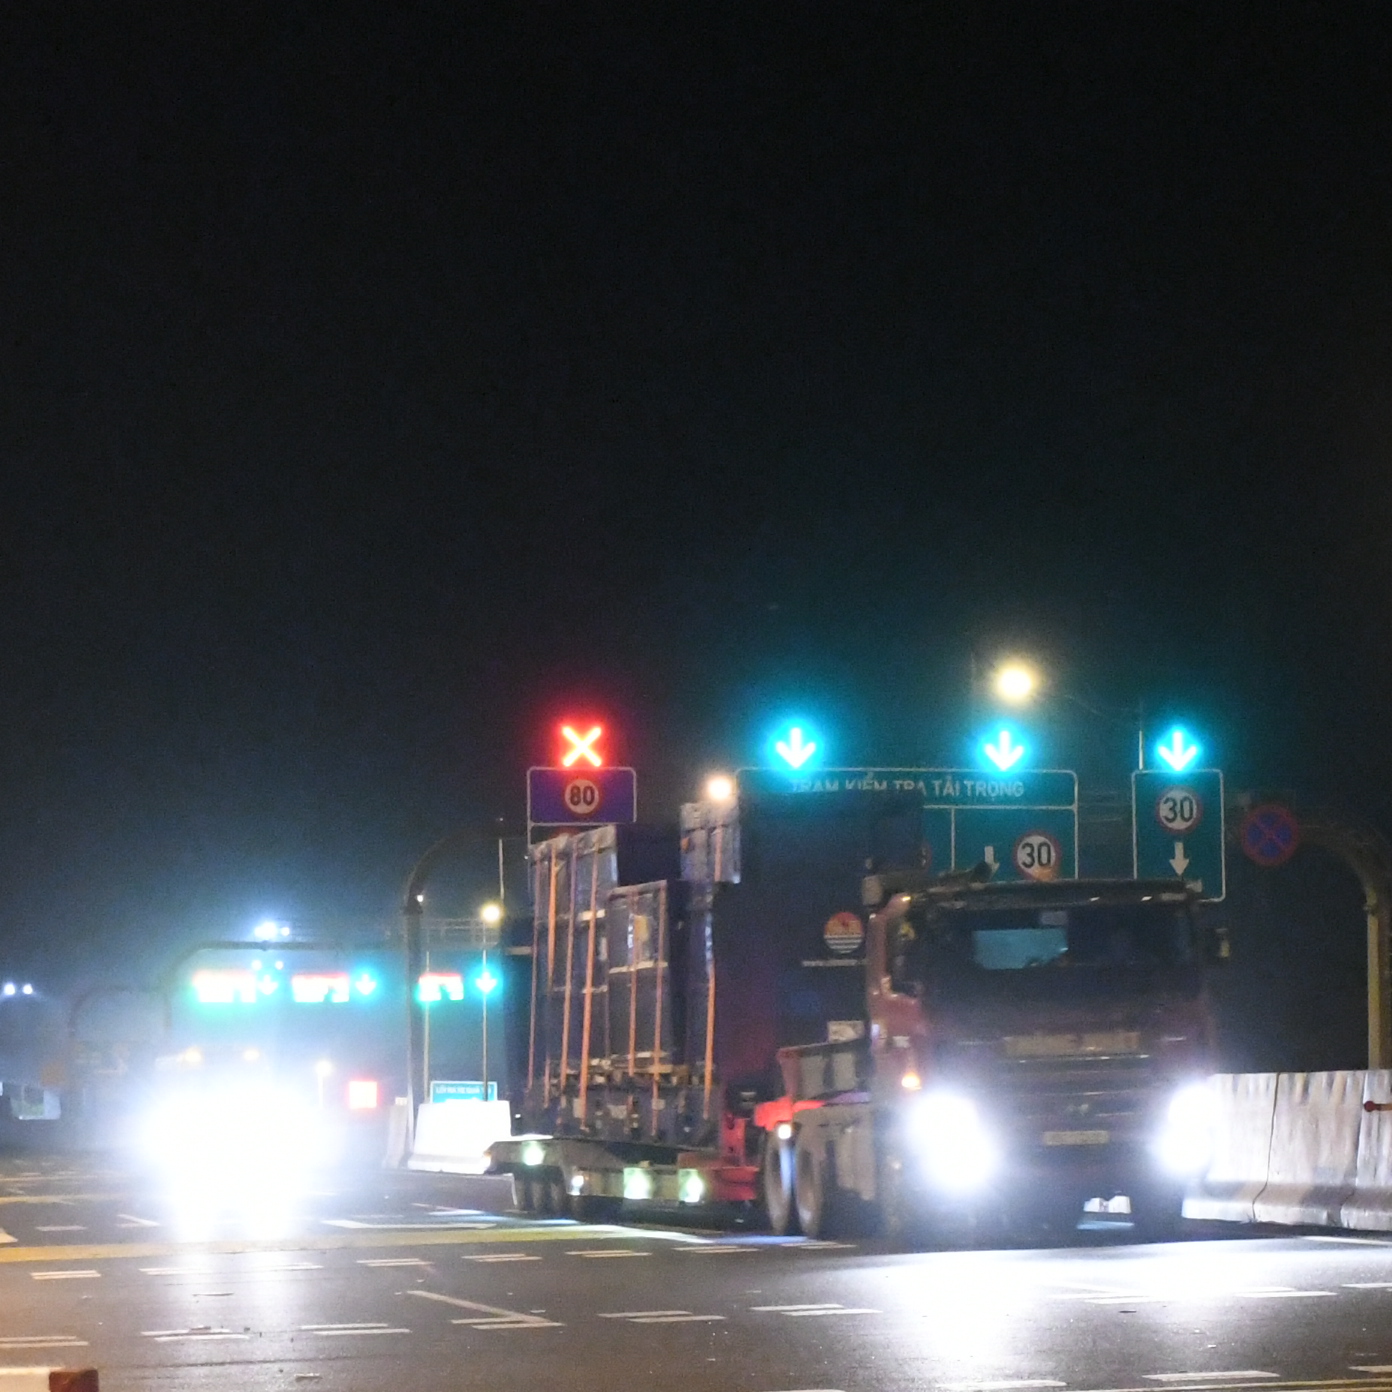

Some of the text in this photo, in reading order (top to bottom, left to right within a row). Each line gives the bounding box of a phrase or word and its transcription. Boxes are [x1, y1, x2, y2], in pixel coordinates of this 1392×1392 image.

[570, 785, 595, 806] 80
[932, 775, 961, 797] TẢI
[963, 780, 1024, 801] TRỌNG
[1163, 796, 1194, 823] 30
[1021, 842, 1051, 868] 30
